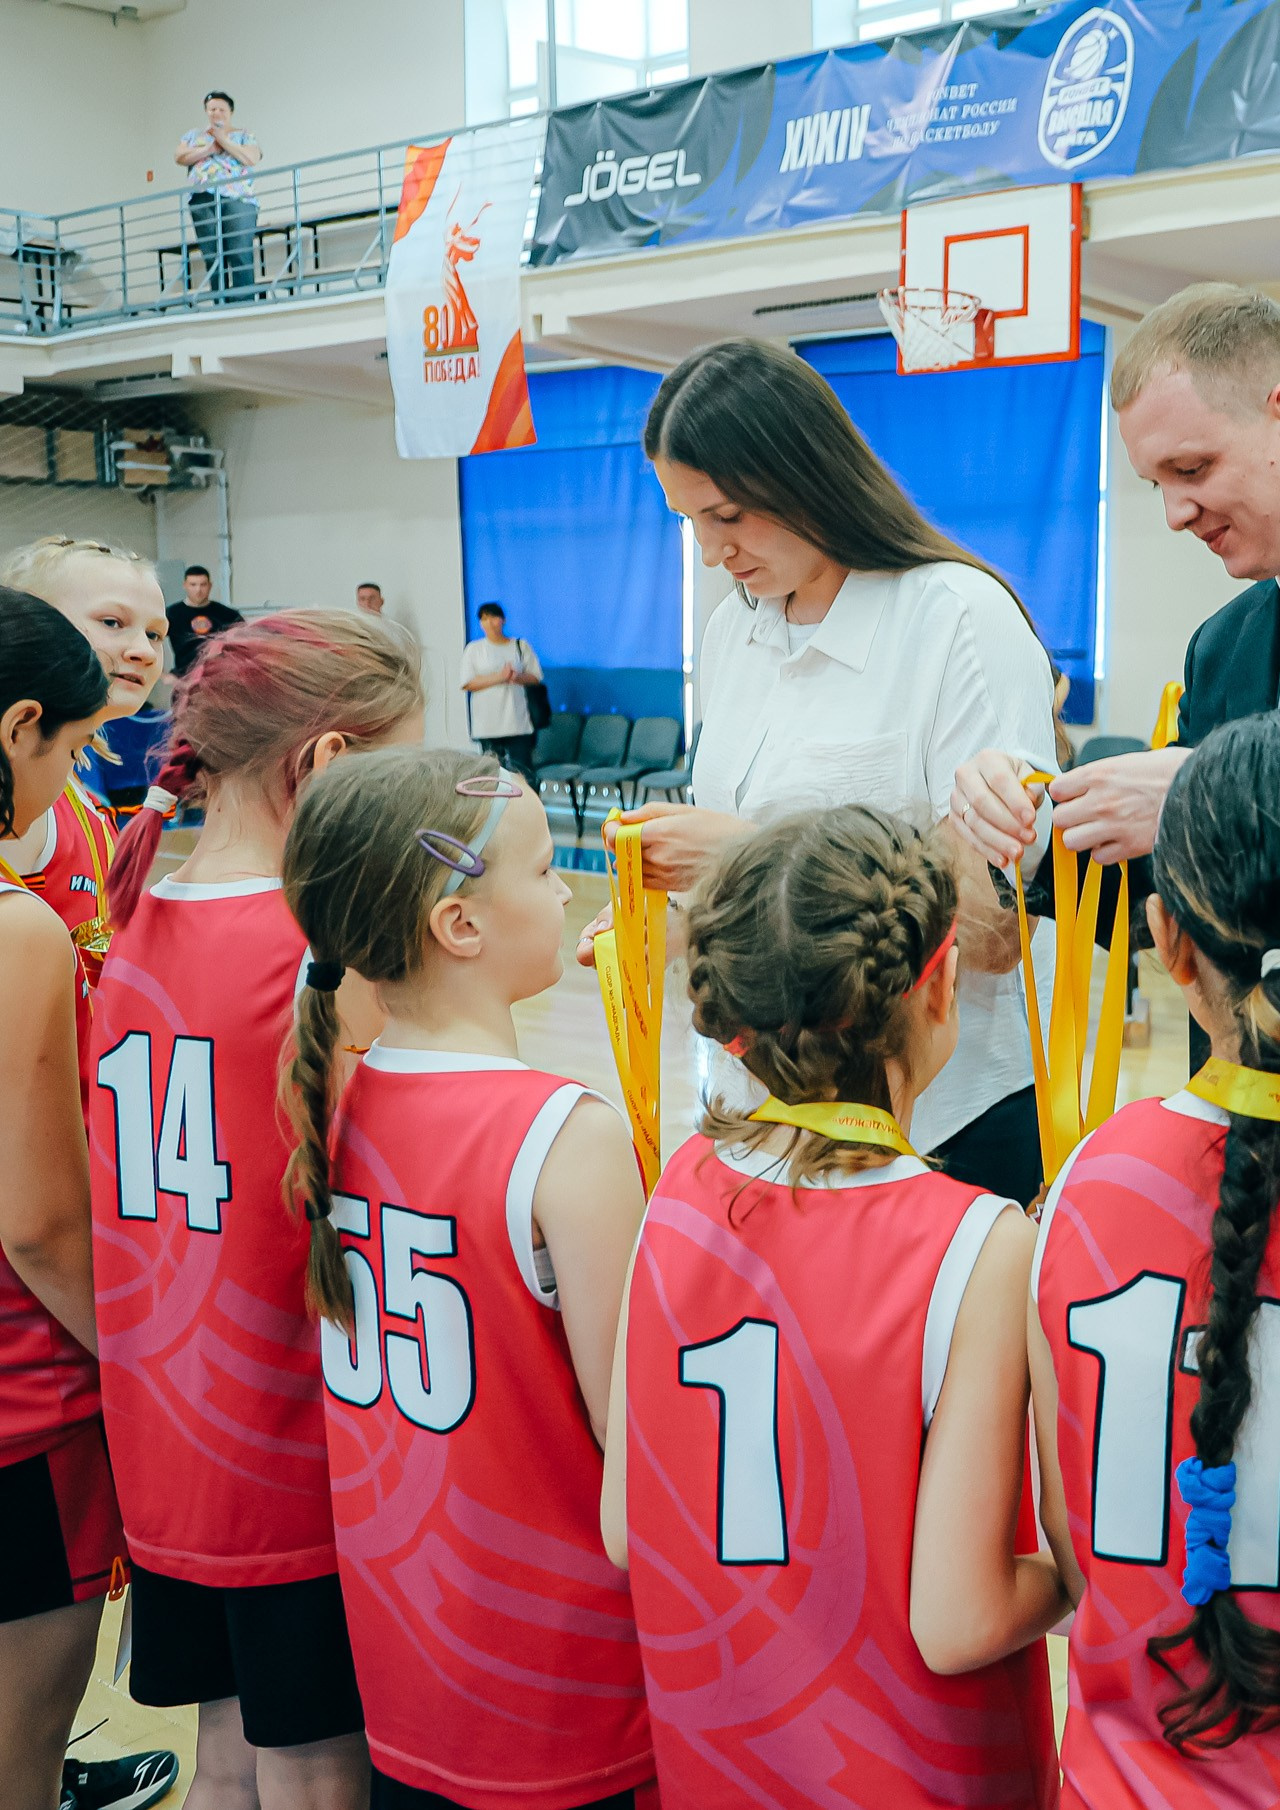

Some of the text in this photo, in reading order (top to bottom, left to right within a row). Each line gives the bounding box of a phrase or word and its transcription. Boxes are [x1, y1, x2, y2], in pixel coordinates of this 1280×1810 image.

[779, 104, 872, 173] XXXIV
[960, 97, 1018, 120] РОССИИ
[564, 149, 701, 208] JÖGEL
[96, 1030, 233, 1235] 14
[320, 1190, 477, 1436] 55
[678, 1316, 790, 1566] 1
